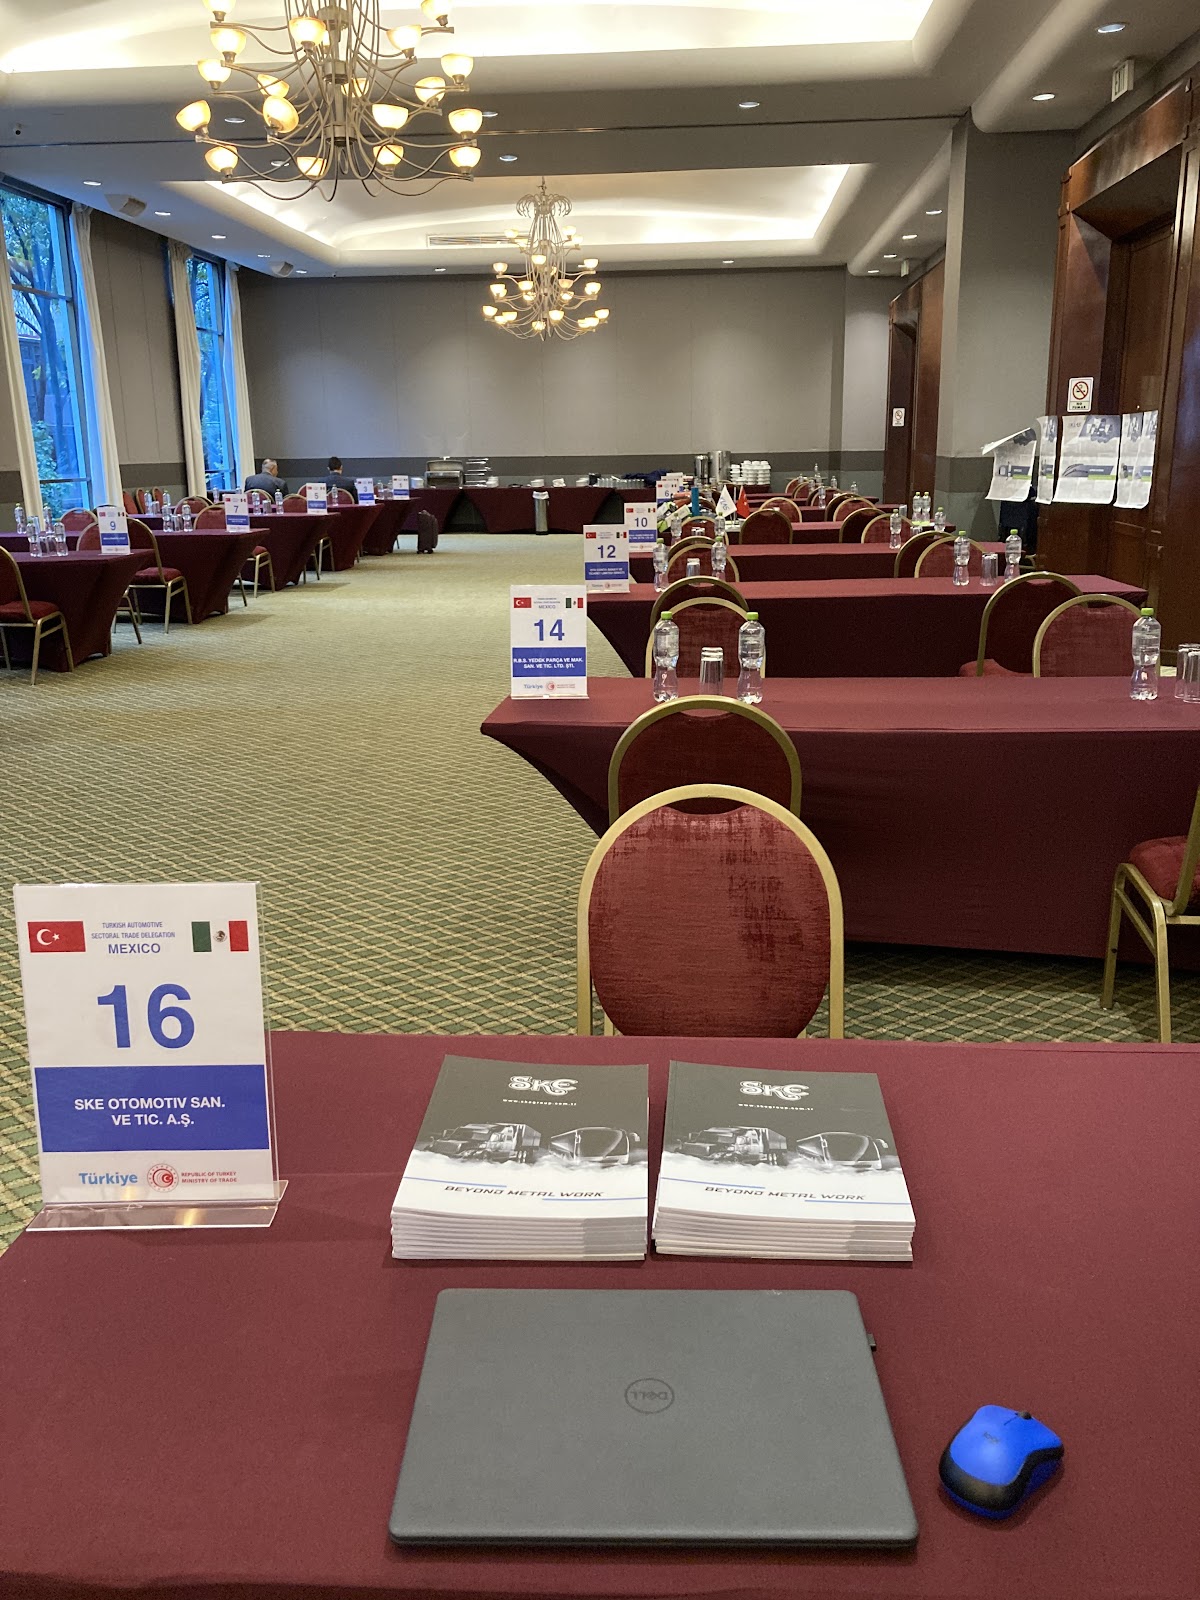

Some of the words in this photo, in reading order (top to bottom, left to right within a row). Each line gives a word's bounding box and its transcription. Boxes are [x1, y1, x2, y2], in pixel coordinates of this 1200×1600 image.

[234, 505, 239, 513] 7
[110, 521, 116, 531] 9
[635, 517, 648, 528] 10
[597, 545, 616, 559] 12
[534, 619, 565, 641] 14
[140, 931, 176, 939] DELEGATION
[108, 943, 161, 954] MEXICO
[97, 983, 195, 1049] 16
[508, 1076, 579, 1096] SKE
[739, 1080, 810, 1101] SKE
[74, 1098, 105, 1110] SKE
[108, 1097, 188, 1110] OTOMOTIV
[190, 1096, 226, 1108] SAN.
[502, 1098, 577, 1106] www.skegroup.com.tr
[738, 1103, 814, 1111] www.skegroup.com.tr
[111, 1114, 132, 1126] VE
[134, 1114, 163, 1126] TIC.
[166, 1113, 195, 1128] A.Ş.
[78, 1172, 138, 1187] Türkiye
[444, 1185, 504, 1195] BEYOND
[704, 1186, 764, 1196] BEYOND
[768, 1191, 817, 1199] METAL
[630, 1391, 668, 1401] DELL
